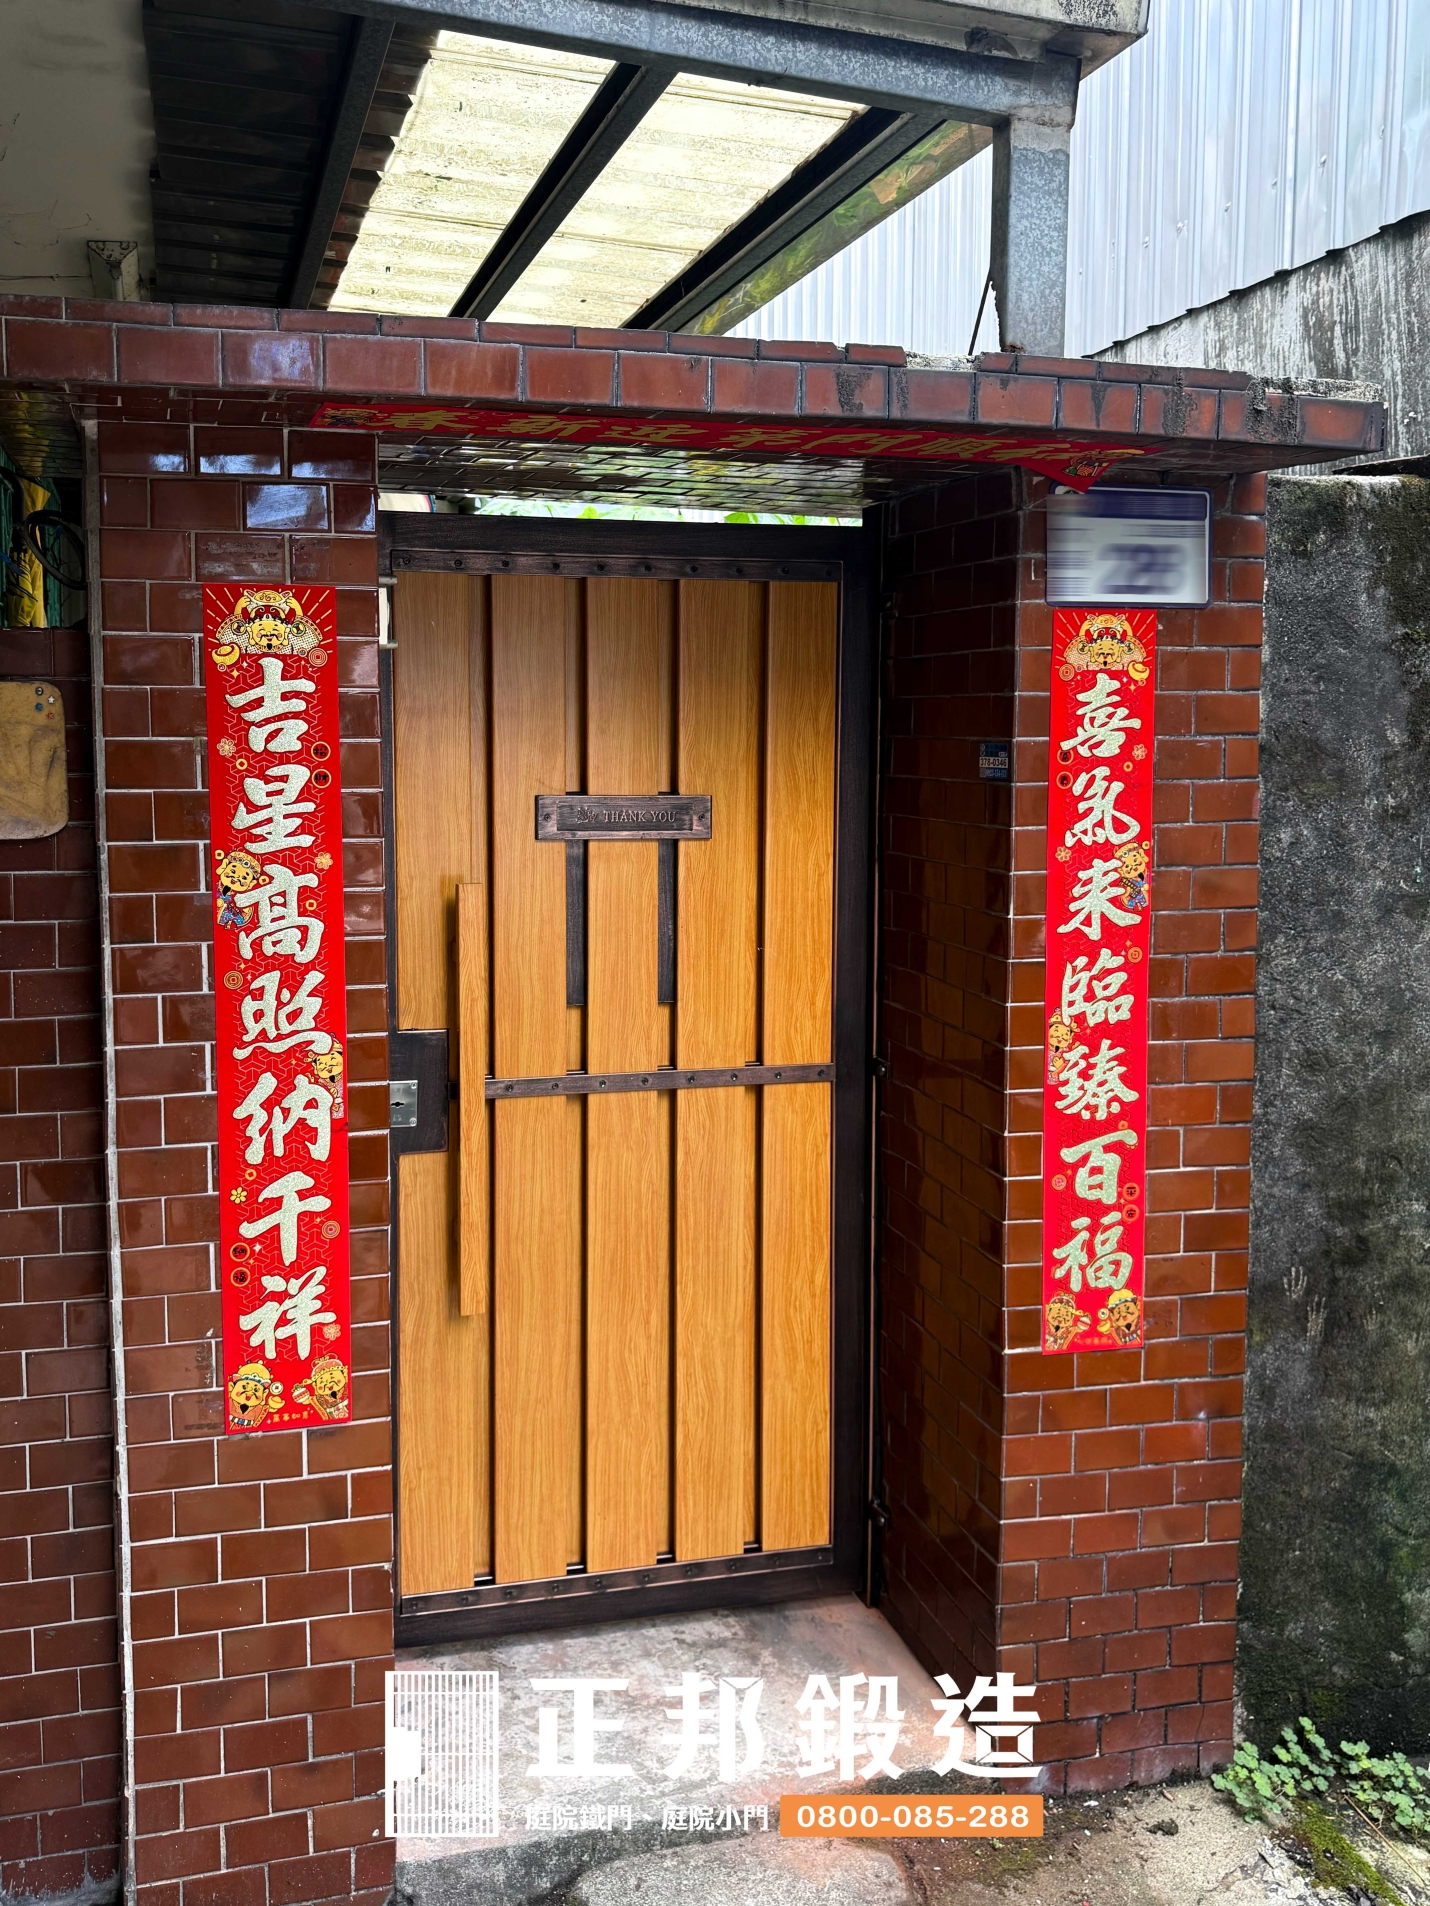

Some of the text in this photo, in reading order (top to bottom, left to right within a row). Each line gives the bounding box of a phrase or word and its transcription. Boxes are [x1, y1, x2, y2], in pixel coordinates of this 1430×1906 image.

[603, 810, 676, 823] THANK YOU
[225, 657, 337, 1361] 吉星高照納千祥
